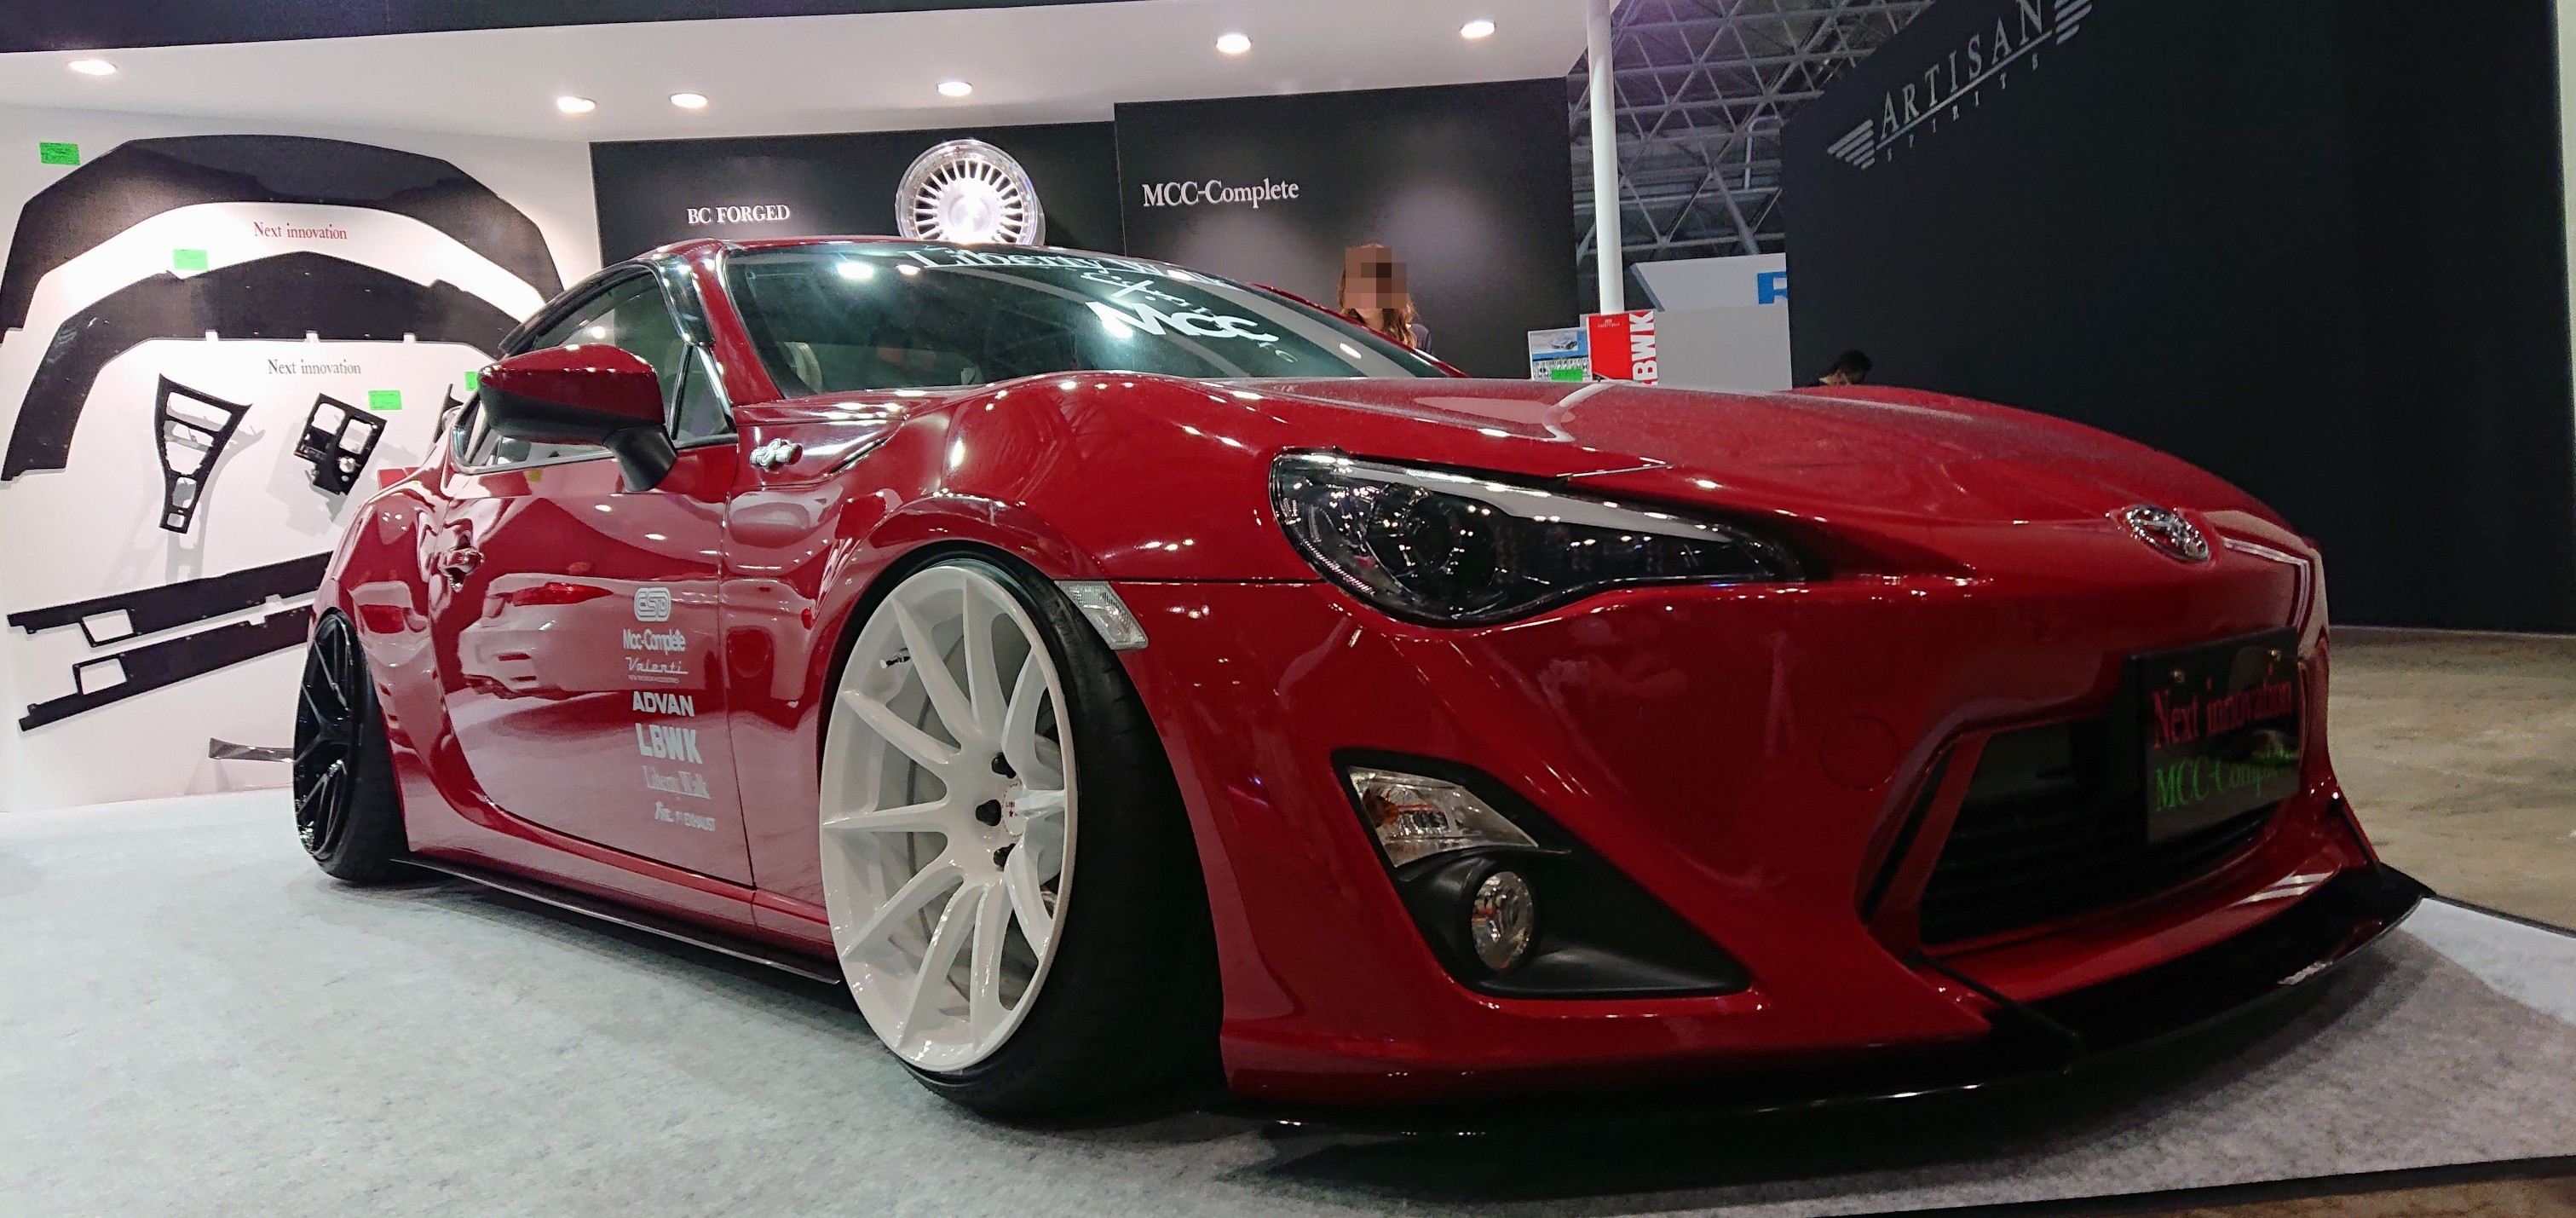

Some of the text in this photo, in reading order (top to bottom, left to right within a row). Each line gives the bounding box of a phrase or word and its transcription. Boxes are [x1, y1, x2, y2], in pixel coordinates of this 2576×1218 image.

[1880, 0, 2043, 140] ARTISAN
[1142, 177, 1300, 209] MCC-Complete
[687, 204, 791, 224] BC FORGED
[253, 222, 348, 240] Next innovation
[1086, 301, 1280, 342] MCC
[268, 359, 362, 375] Next innovation
[632, 690, 694, 718] ADVAN
[2151, 688, 2199, 749] Next
[635, 723, 703, 765] LBWK
